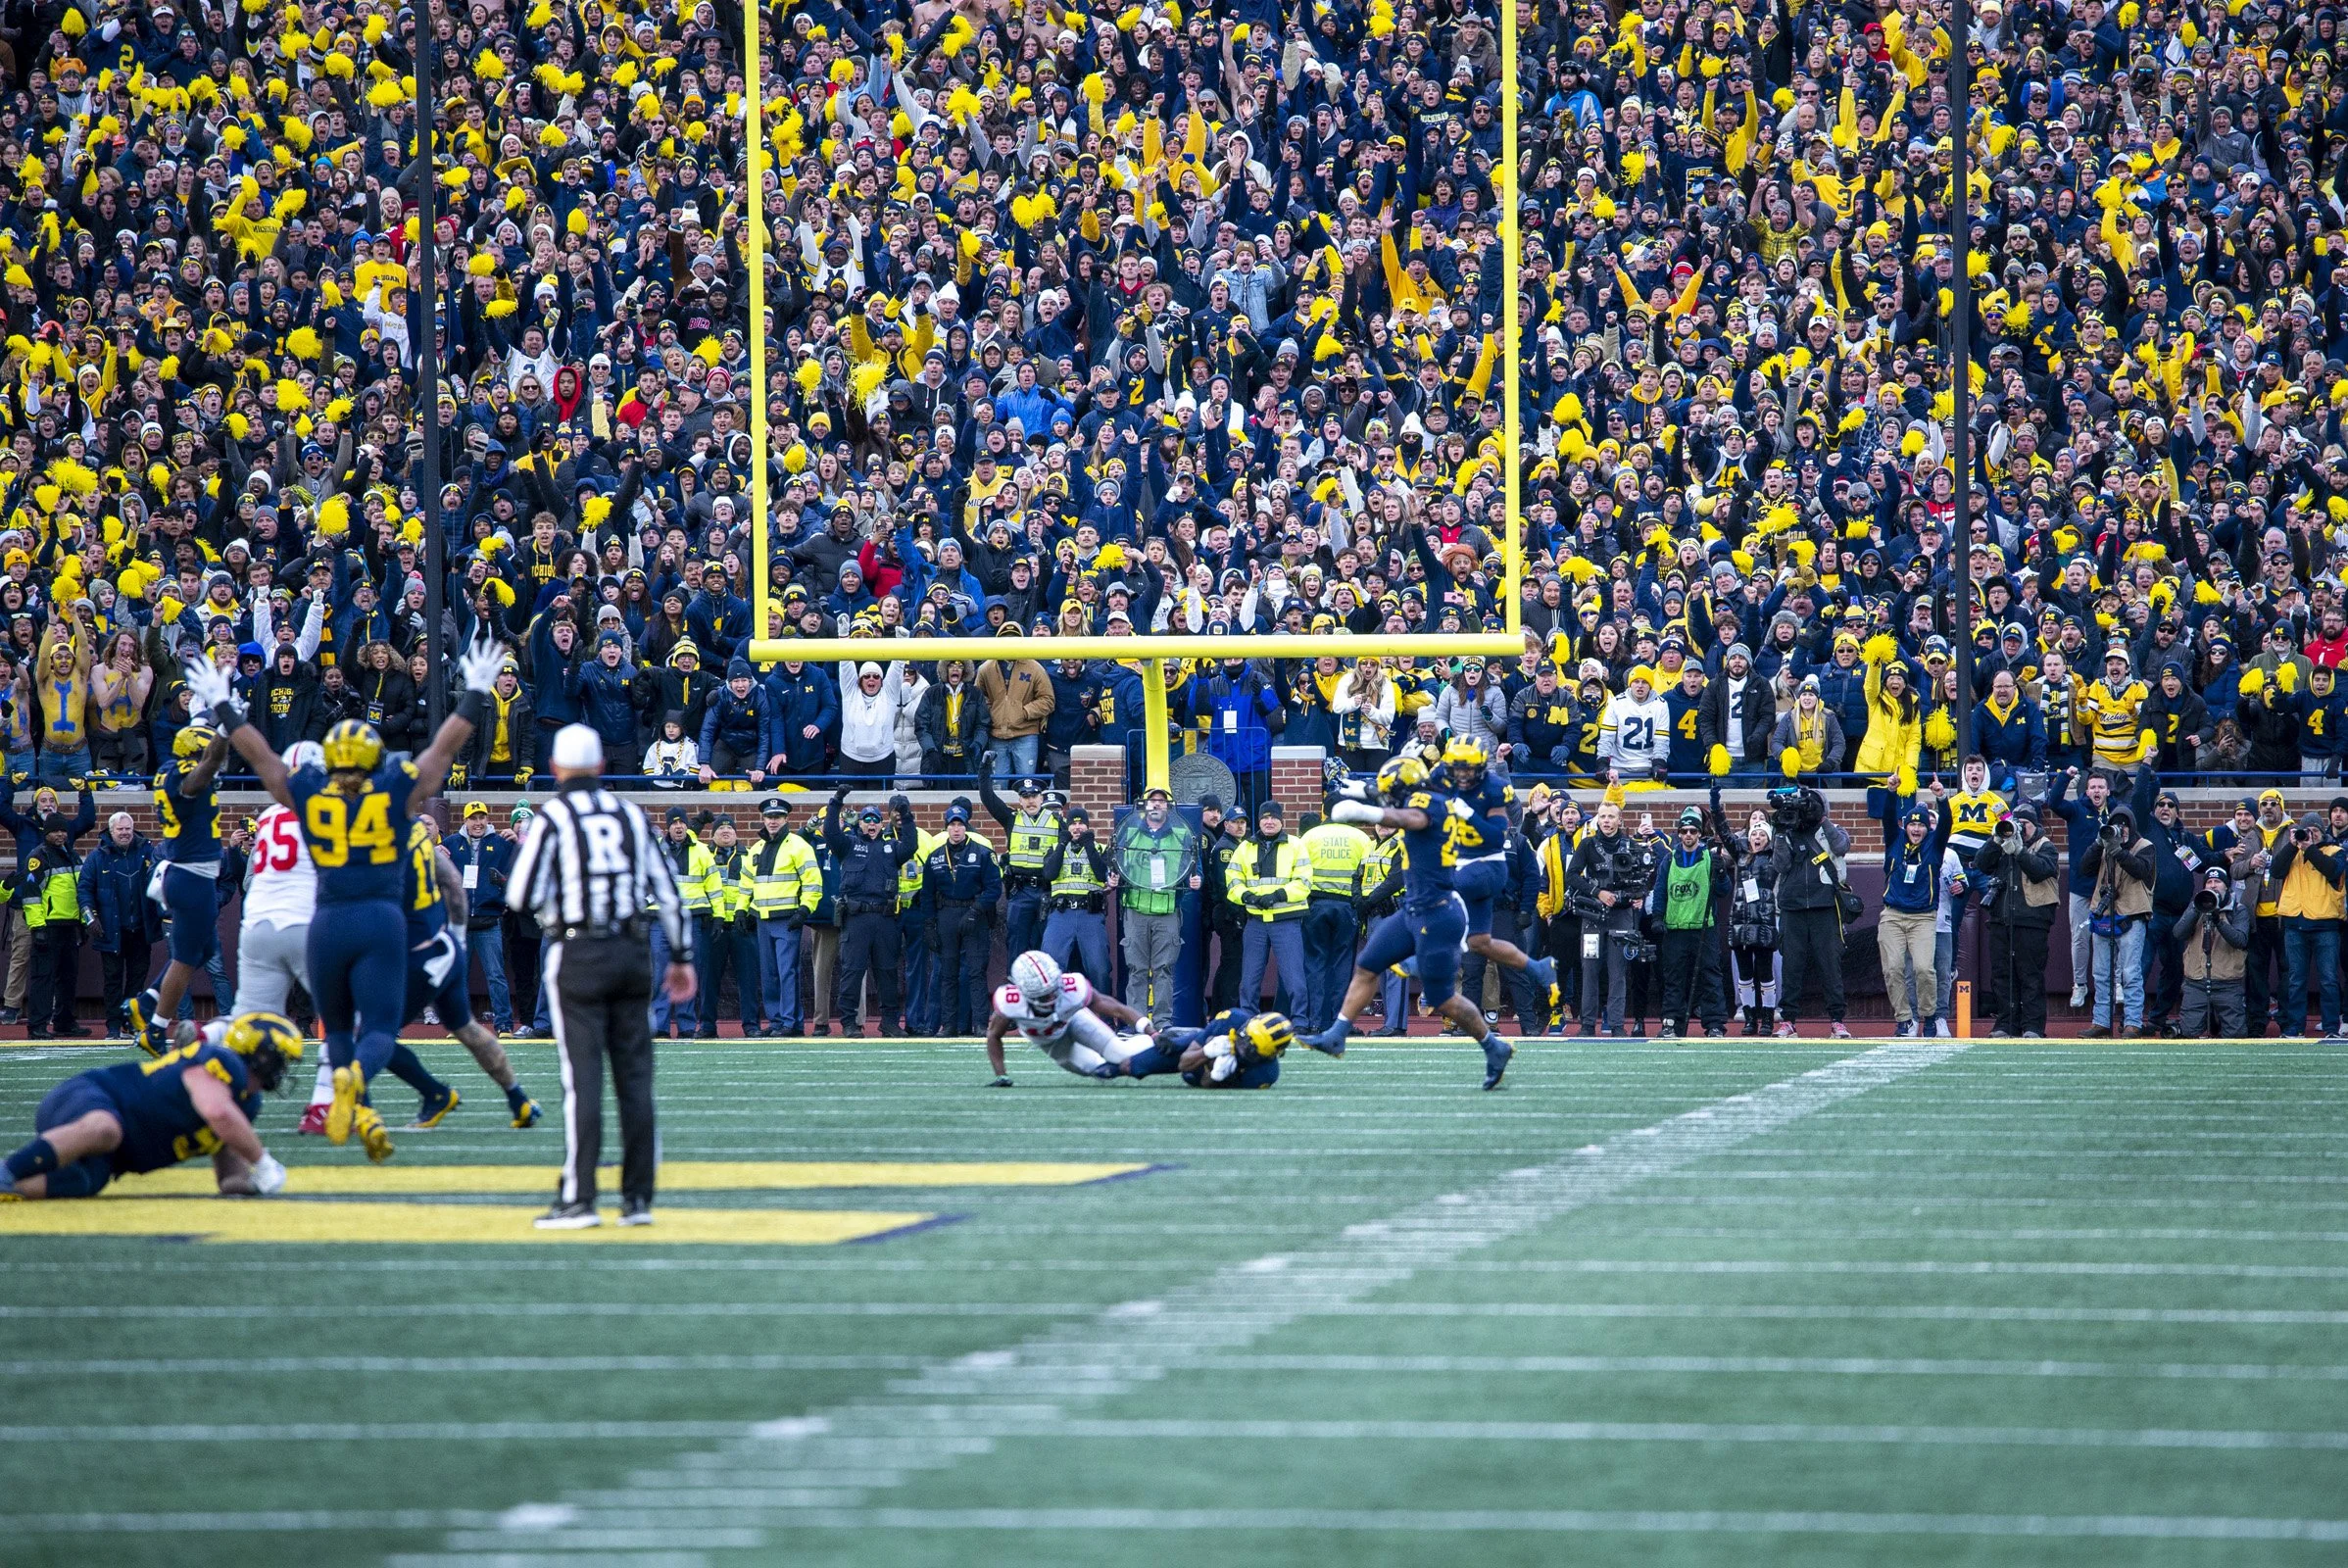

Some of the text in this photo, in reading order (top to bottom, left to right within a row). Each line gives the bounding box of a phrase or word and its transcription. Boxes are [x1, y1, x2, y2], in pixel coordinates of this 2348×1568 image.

[119, 43, 134, 74] 2
[1836, 189, 1854, 212] 3
[273, 336, 285, 357] 1
[1129, 377, 1145, 406] 2
[532, 564, 556, 578] ICHIGA
[1547, 705, 1569, 725] M
[1678, 709, 1697, 740] 4
[2307, 709, 2324, 736] 4
[1578, 723, 1598, 755] 2
[1623, 716, 1654, 750] 21
[2167, 713, 2179, 744] 2
[1408, 792, 1432, 808] 25
[1959, 802, 1988, 823] M
[308, 794, 398, 867] 94
[579, 812, 630, 872] R
[1322, 836, 1348, 848] STATE
[1319, 849, 1351, 860] POLICE
[1675, 883, 1692, 895] FOX
